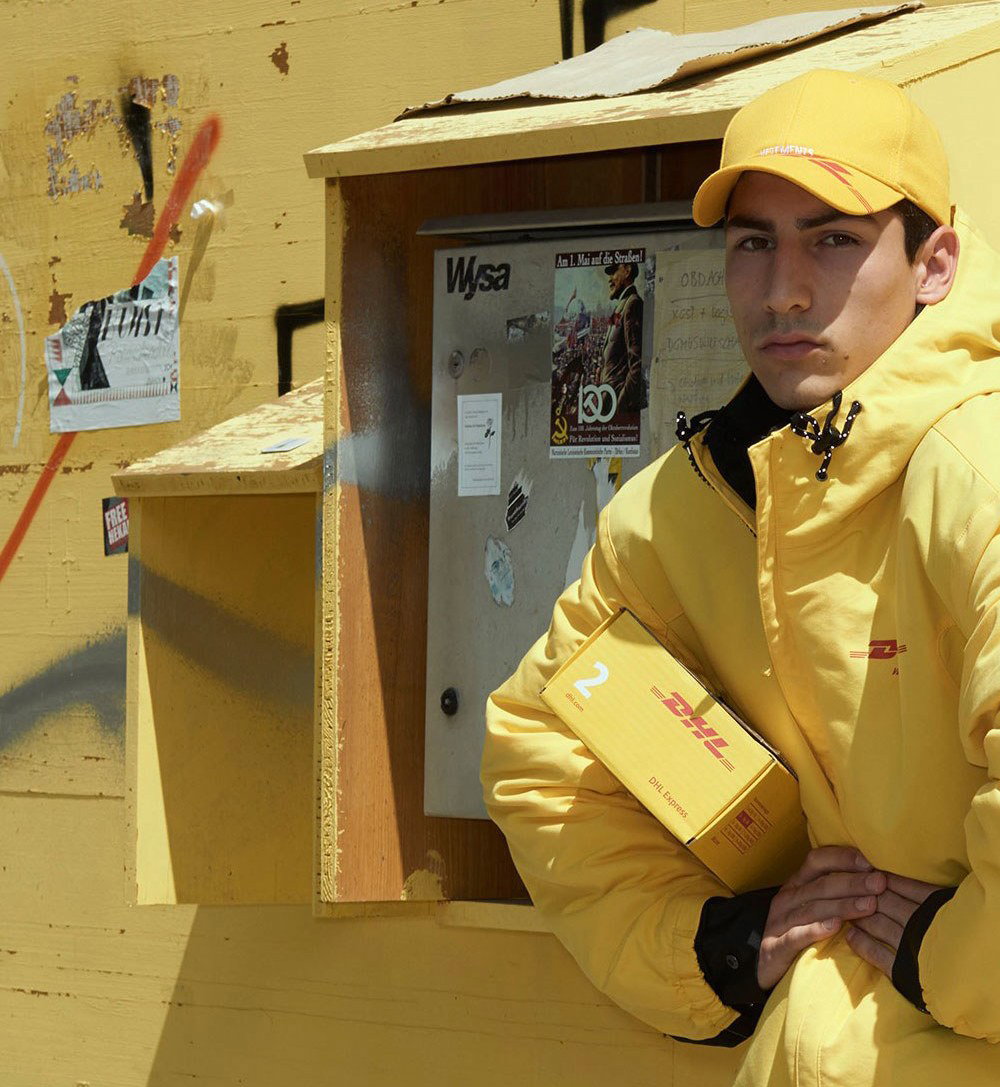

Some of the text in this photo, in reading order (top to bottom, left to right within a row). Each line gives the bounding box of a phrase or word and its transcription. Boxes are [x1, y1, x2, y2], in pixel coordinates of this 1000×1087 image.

[446, 256, 511, 300] Wysa
[556, 250, 643, 268] Am 1. Mai auf die Straßen!
[104, 502, 128, 530] FREE
[574, 661, 609, 698] 2
[661, 690, 730, 760] DHL
[648, 776, 688, 818] DHL Express
